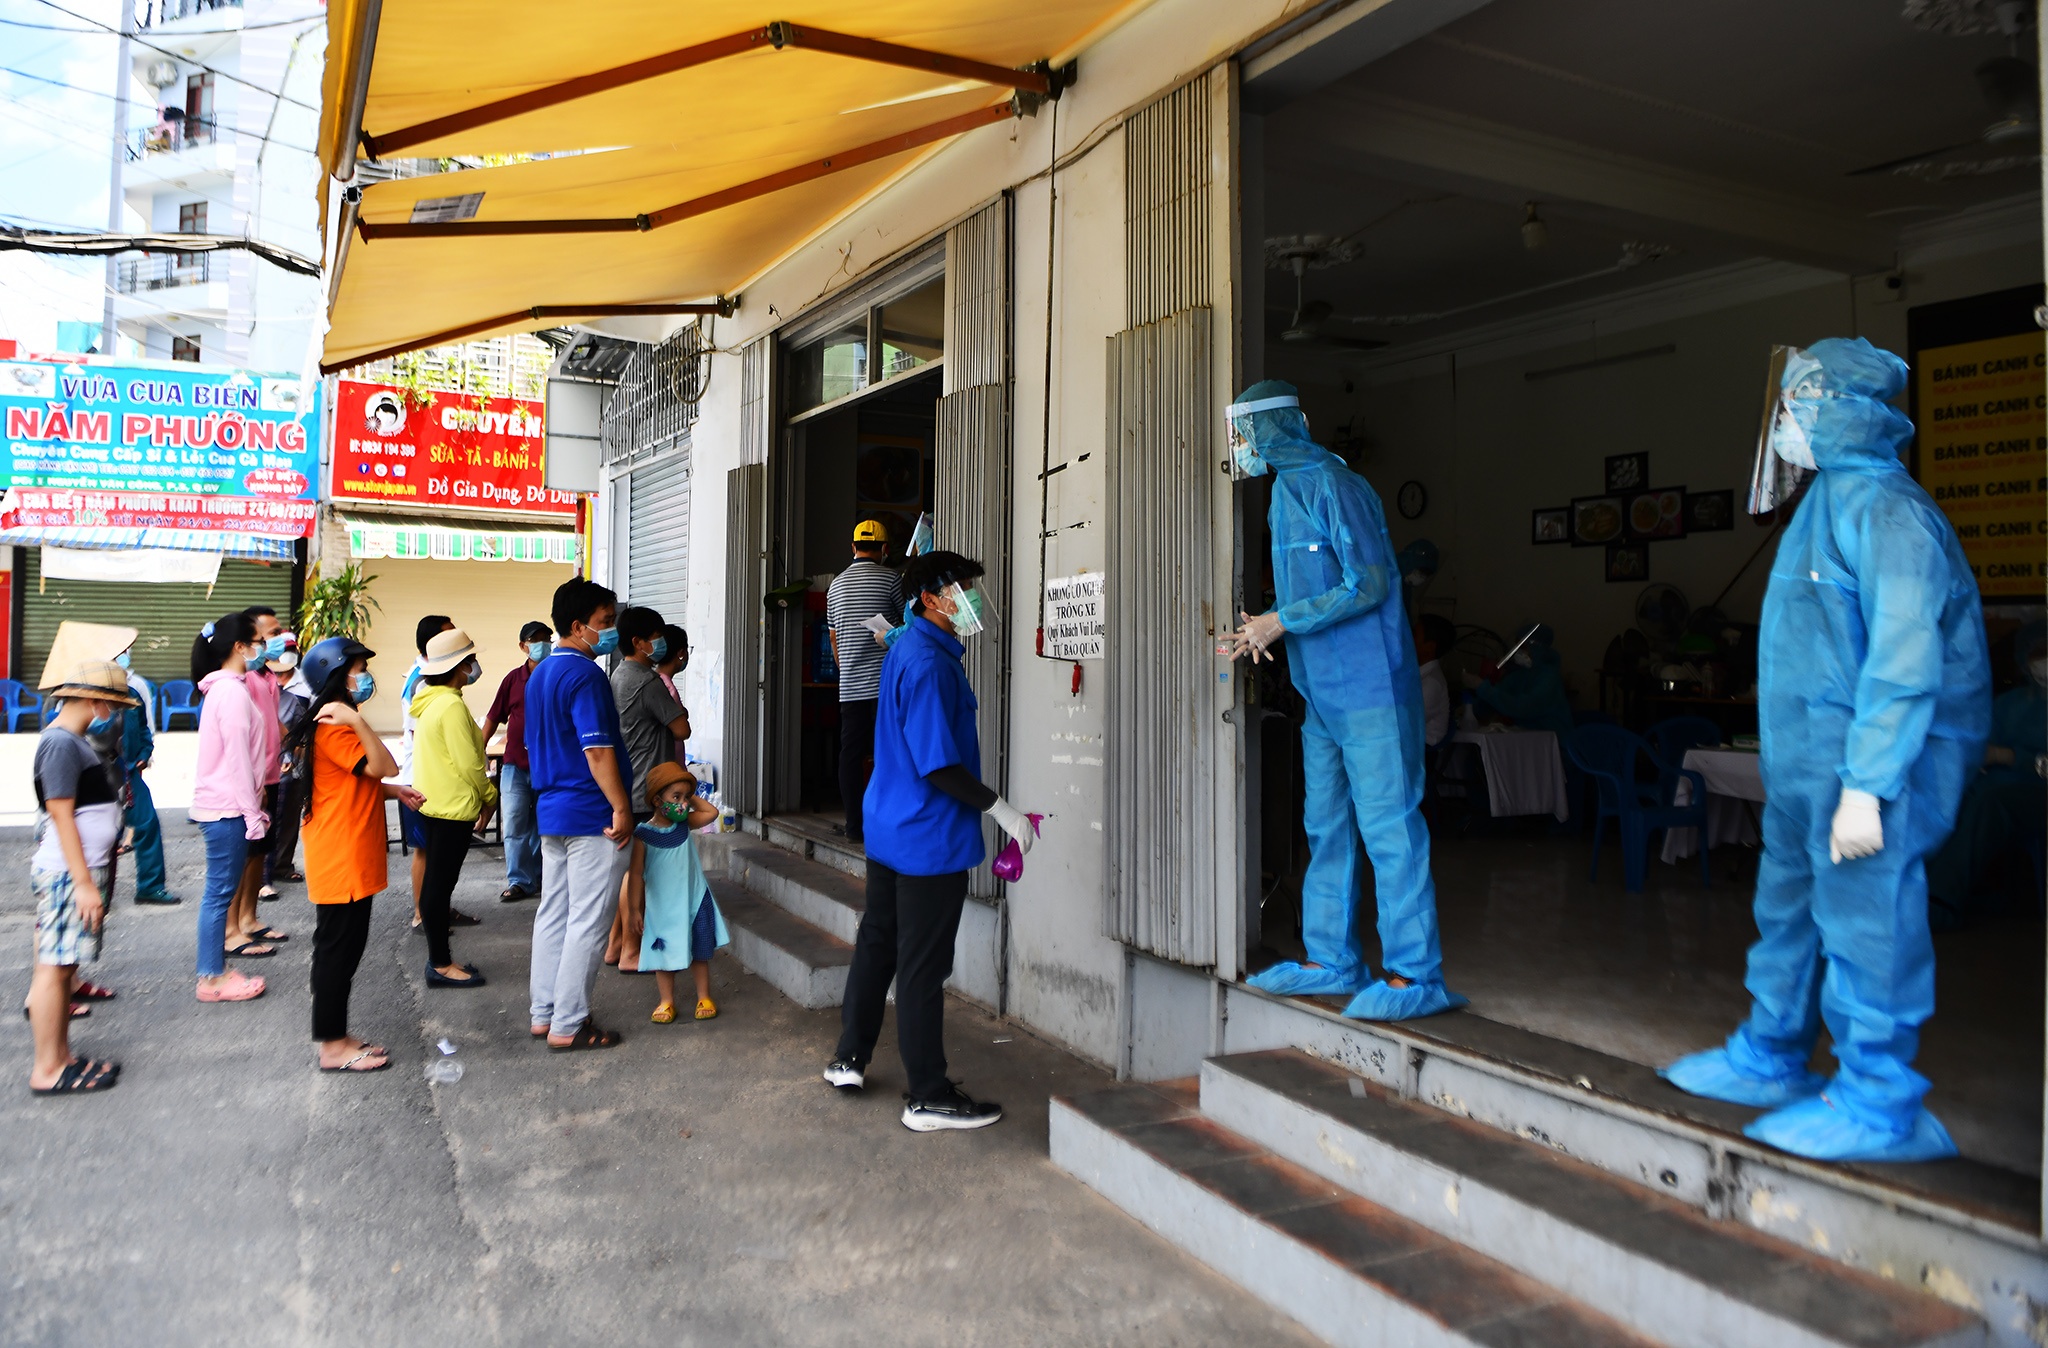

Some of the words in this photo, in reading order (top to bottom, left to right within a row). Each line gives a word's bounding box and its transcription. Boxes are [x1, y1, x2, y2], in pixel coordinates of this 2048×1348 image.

[1933, 362, 1977, 382] BÁNH
[1983, 355, 2028, 375] CANH
[129, 380, 183, 405] CUA
[1934, 401, 1978, 421] BÁNH
[1984, 397, 2029, 415] CANH
[7, 401, 111, 444] NĂM
[69, 446, 109, 462] Cung
[164, 450, 178, 463] &
[208, 452, 236, 465] Cua
[239, 453, 258, 467] Cà
[262, 455, 292, 468] Mau
[1934, 442, 1979, 461] BÁNH
[1984, 438, 2030, 456] CANH
[453, 480, 478, 498] Gia
[1935, 482, 1979, 500] BÁNH
[1985, 479, 2031, 496] CANH
[73, 509, 108, 526] 10%
[1986, 520, 2032, 537] CANH
[1986, 563, 2032, 578] CANH
[1085, 603, 1096, 616] XE
[1079, 622, 1090, 637] Vui
